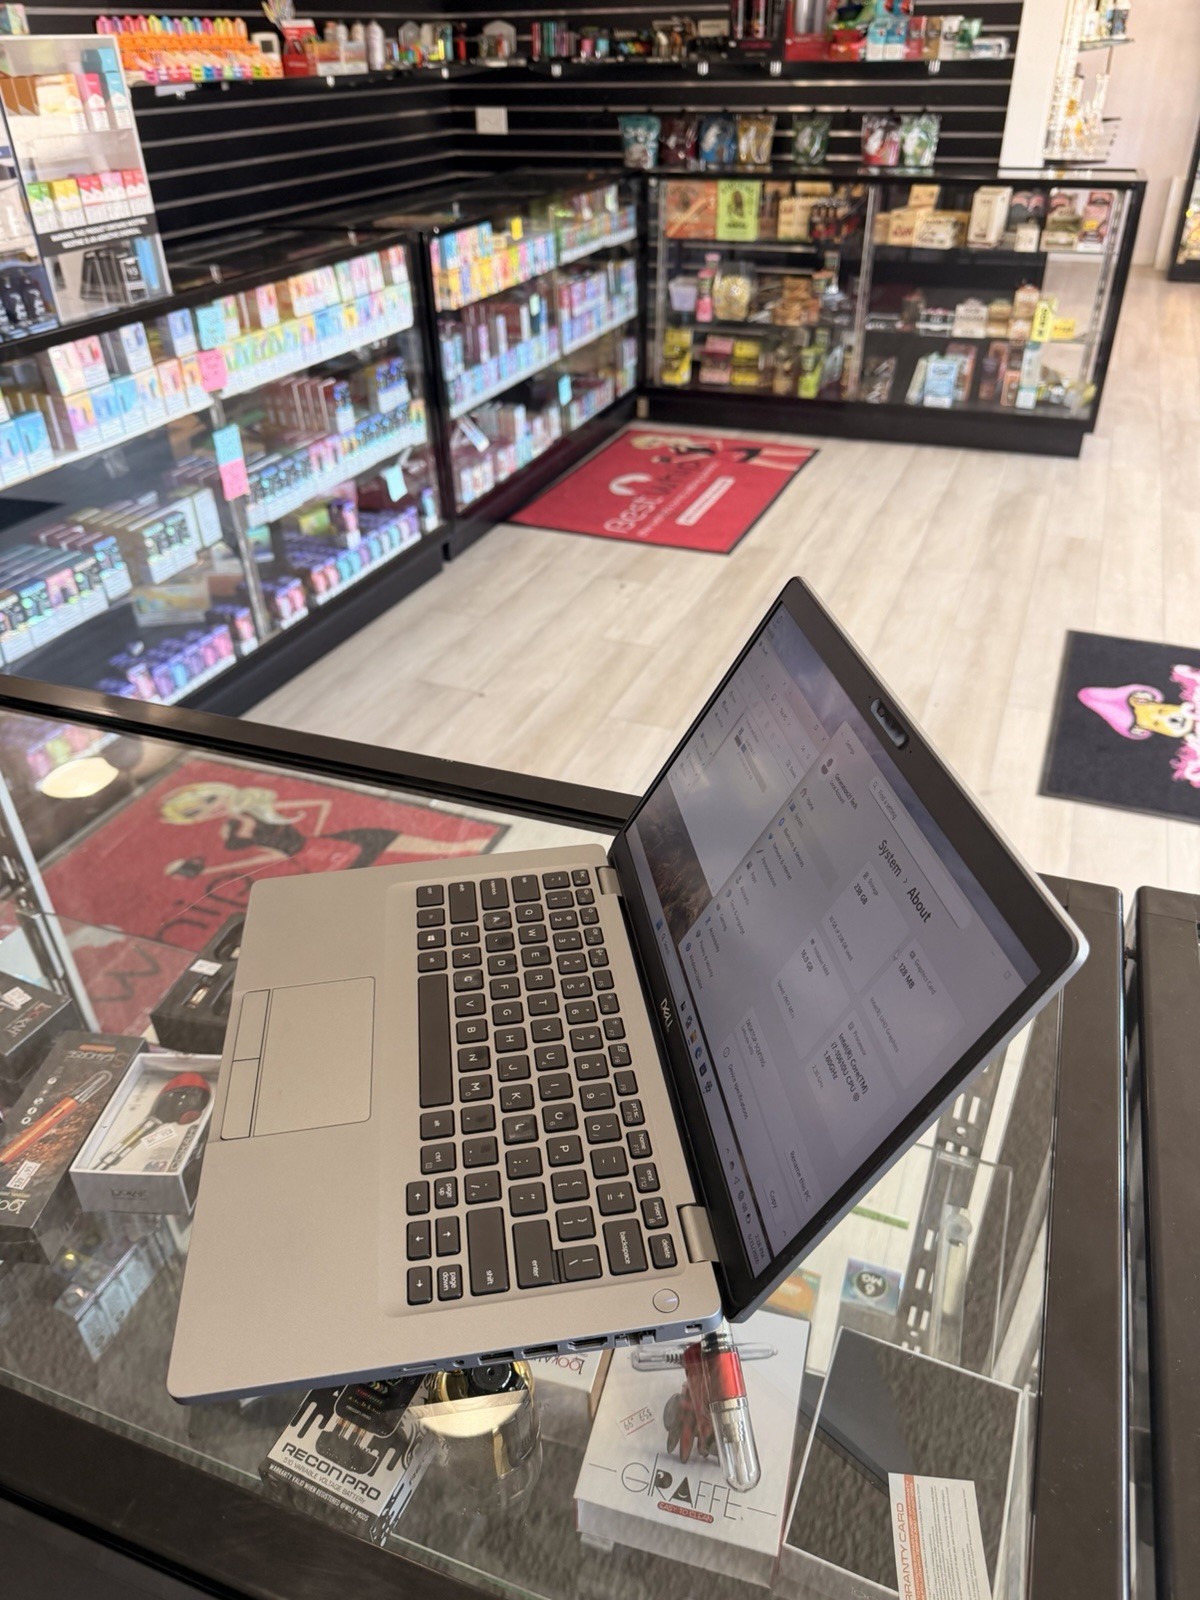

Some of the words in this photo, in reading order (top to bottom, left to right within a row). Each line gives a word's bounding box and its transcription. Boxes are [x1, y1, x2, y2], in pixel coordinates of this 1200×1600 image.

[877, 789, 886, 802] Find
[884, 802, 897, 820] setting
[794, 850, 804, 868] devices
[853, 882, 862, 896] 238
[859, 892, 868, 905] GB
[866, 877, 879, 897] Storage
[876, 839, 902, 879] System
[907, 885, 932, 922] About
[800, 948, 808, 963] 16.0
[805, 960, 813, 972] GB
[813, 945, 824, 965] Installed
[821, 963, 829, 977] RAM
[897, 962, 908, 977] 128
[904, 974, 914, 990] MB
[913, 958, 929, 982] Graphics
[926, 979, 936, 995] Card
[661, 998, 673, 1032] DELL
[852, 1030, 867, 1056] Processor
[878, 1014, 888, 1030] UHD
[884, 1027, 899, 1053] Graphics
[823, 1050, 838, 1080] 1.80GHz
[838, 1032, 853, 1060] Intel(R)
[849, 1058, 868, 1094] Core(TM)
[728, 1062, 736, 1082] Device
[733, 1081, 748, 1119] specifications
[845, 1074, 856, 1093] CPU
[560, 1144, 570, 1153] P
[639, 1133, 647, 1150] home
[646, 1169, 654, 1182] end
[789, 1150, 802, 1178] Rename
[803, 1189, 810, 1203] PC
[653, 1201, 663, 1220] insert
[768, 1189, 778, 1210] Copy
[620, 1231, 632, 1265] backspace
[661, 1238, 671, 1259] delete
[486, 1269, 494, 1286] shift
[532, 1259, 540, 1278] enter
[268, 1462, 292, 1482] WARRANTY
[291, 1476, 305, 1490] VALID
[303, 1483, 317, 1497] WHEN
[316, 1486, 341, 1506] REGISTERED
[356, 1508, 370, 1522] MODS
[283, 1456, 294, 1466] 510
[294, 1460, 319, 1480] VARIABLE
[318, 1474, 342, 1494] VOLTAGE
[342, 1486, 366, 1504] BATTERY
[658, 1500, 678, 1514] EASY
[678, 1506, 690, 1516] TO
[689, 1509, 714, 1524] CLEAN
[896, 1502, 907, 1542] CARD
